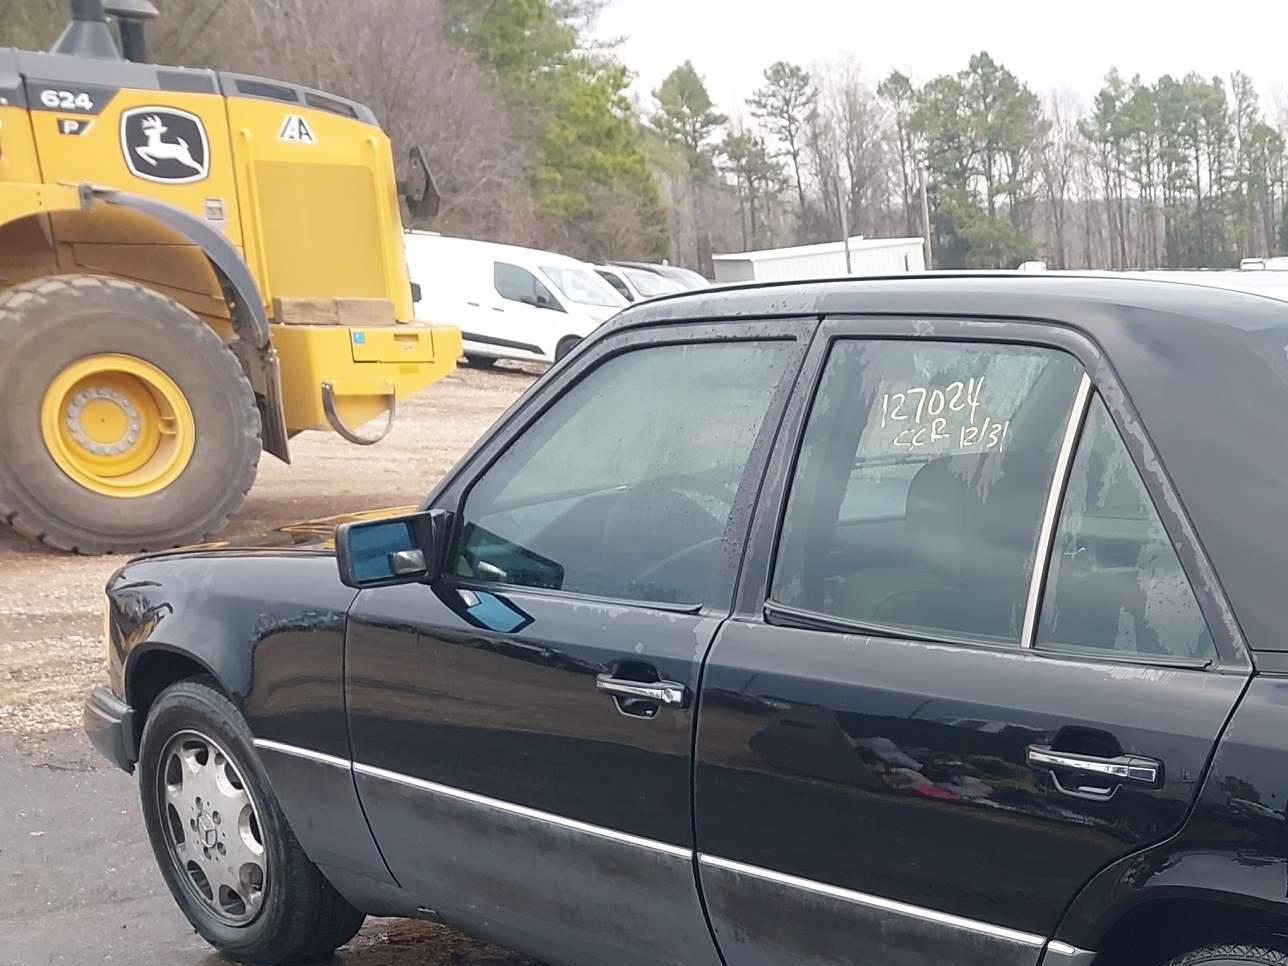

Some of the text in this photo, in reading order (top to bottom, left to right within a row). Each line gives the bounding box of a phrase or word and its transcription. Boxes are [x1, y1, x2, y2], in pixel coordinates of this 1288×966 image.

[40, 90, 94, 111] 624
[63, 120, 80, 135] P
[881, 376, 985, 428] 127024
[960, 417, 1010, 453] 12/31
